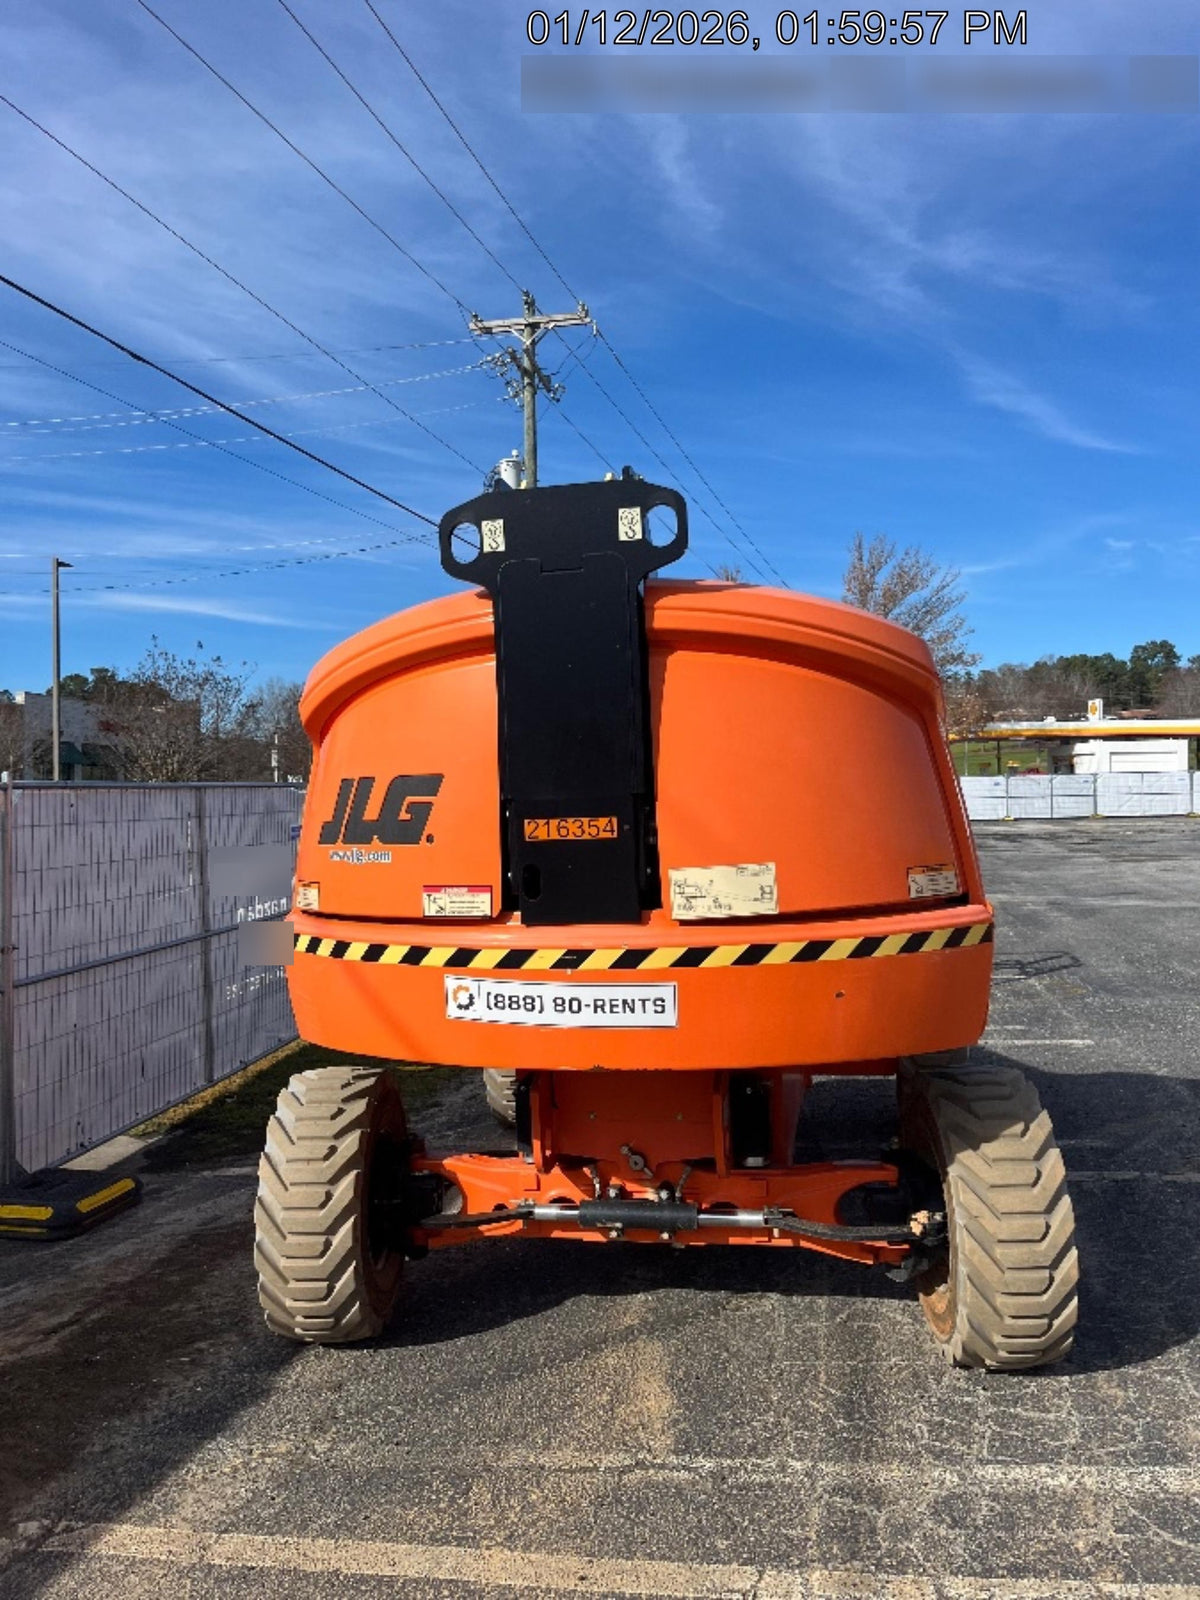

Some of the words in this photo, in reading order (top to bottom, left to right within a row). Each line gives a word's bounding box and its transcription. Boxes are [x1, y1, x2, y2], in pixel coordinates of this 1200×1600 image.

[318, 773, 445, 845] JLG
[526, 818, 617, 840] 216354
[553, 992, 667, 1015] 80-RENTS
